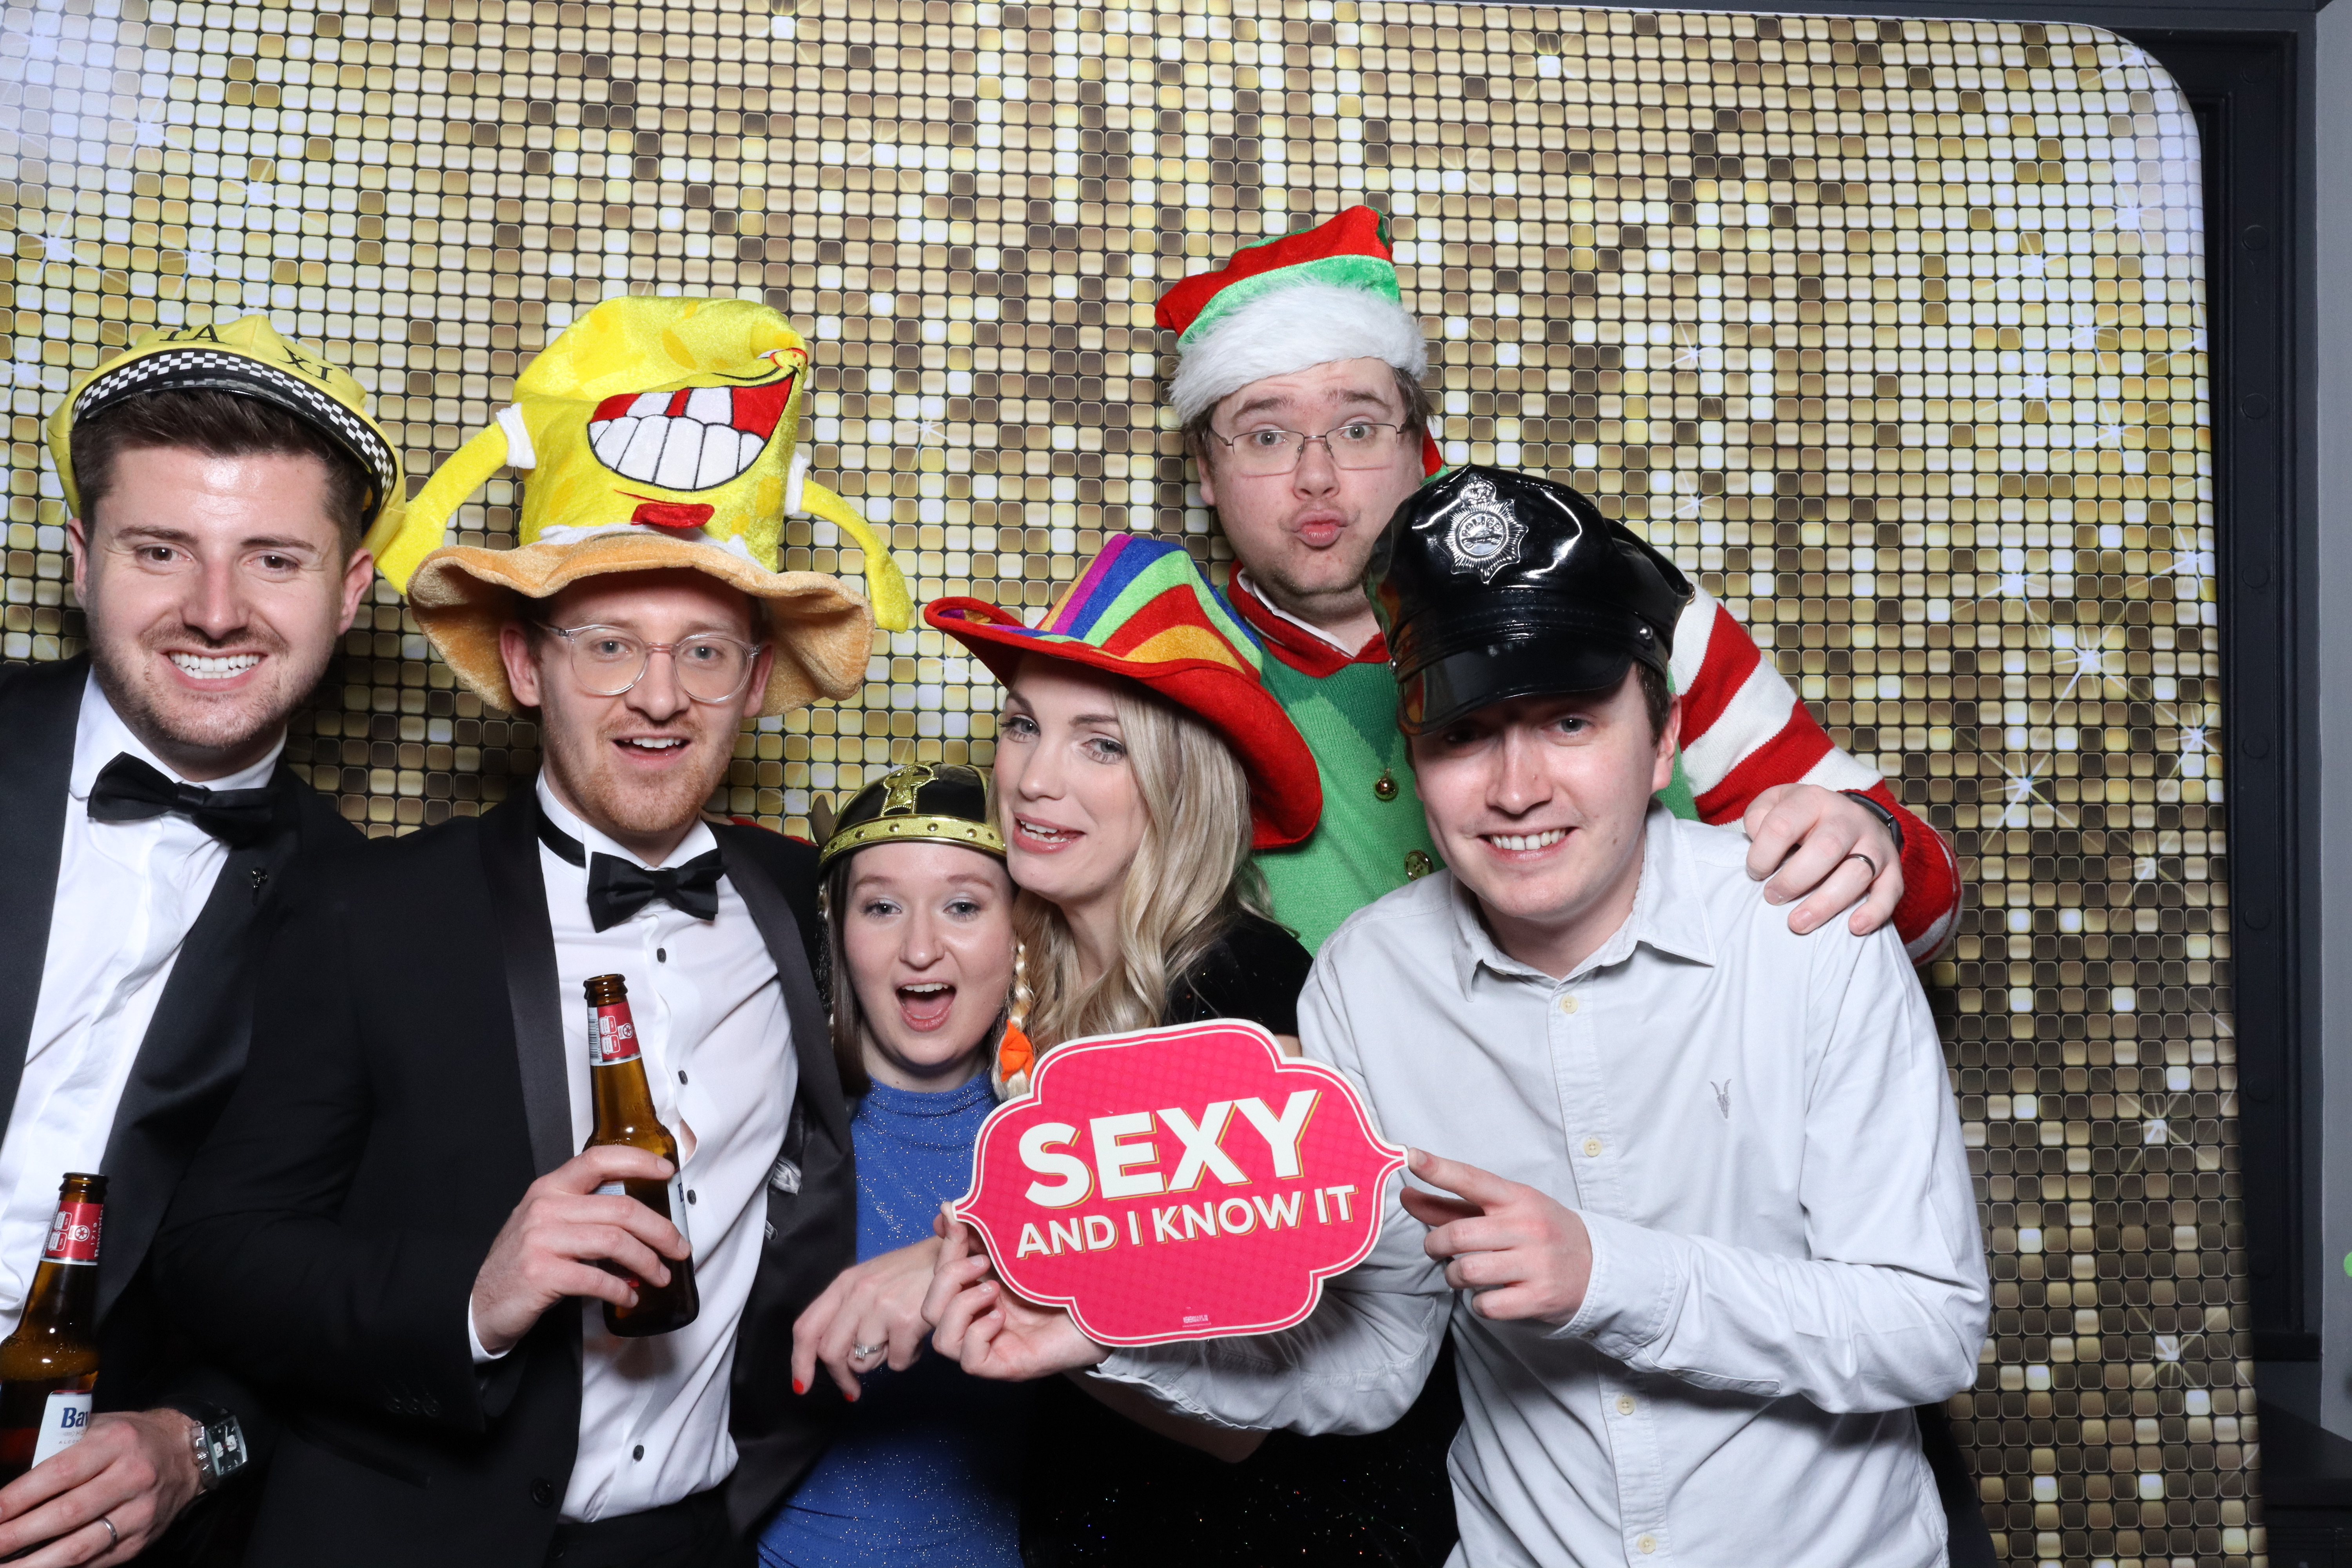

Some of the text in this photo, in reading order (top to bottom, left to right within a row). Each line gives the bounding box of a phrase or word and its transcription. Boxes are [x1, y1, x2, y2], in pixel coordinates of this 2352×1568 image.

[160, 324, 333, 383] TAXI
[1461, 516, 1503, 537] POLICE
[1018, 1089, 1322, 1209] SEXY
[1016, 1184, 1359, 1260] AND I KNOW IT
